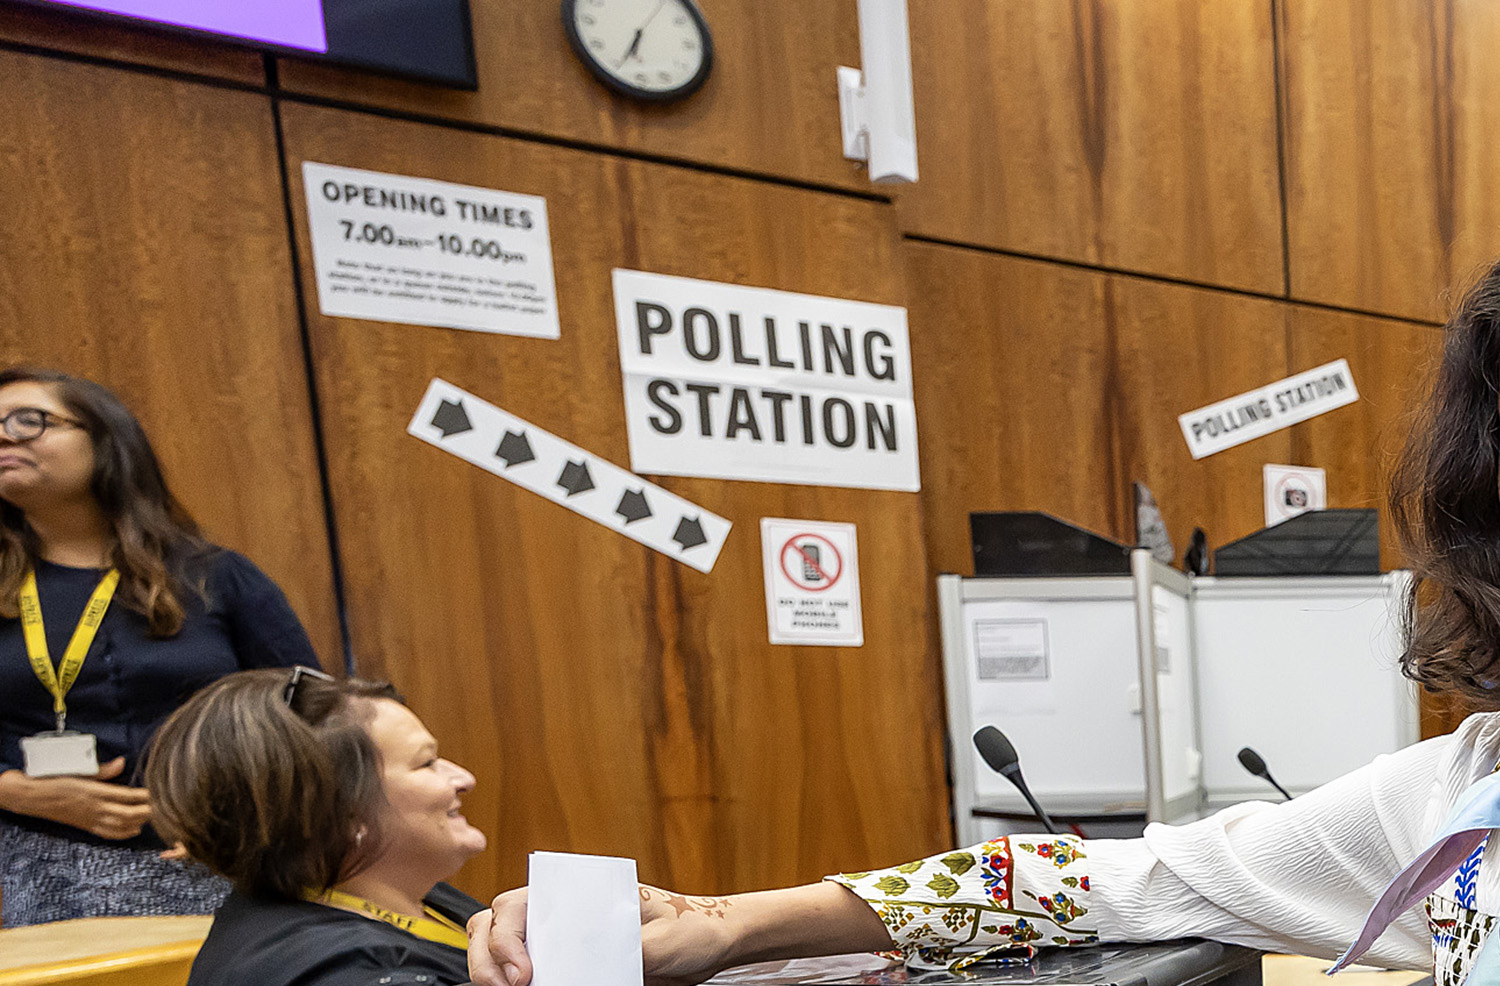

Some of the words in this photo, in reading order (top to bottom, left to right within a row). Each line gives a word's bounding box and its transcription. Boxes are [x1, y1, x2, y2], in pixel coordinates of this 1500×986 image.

[322, 181, 446, 217] OPENING
[455, 200, 533, 229] TIMES
[634, 301, 896, 382] POLLING
[646, 379, 898, 451] STATION
[1191, 398, 1273, 443] POLLING
[1275, 372, 1347, 413] STATION
[363, 902, 418, 929] STAFF
